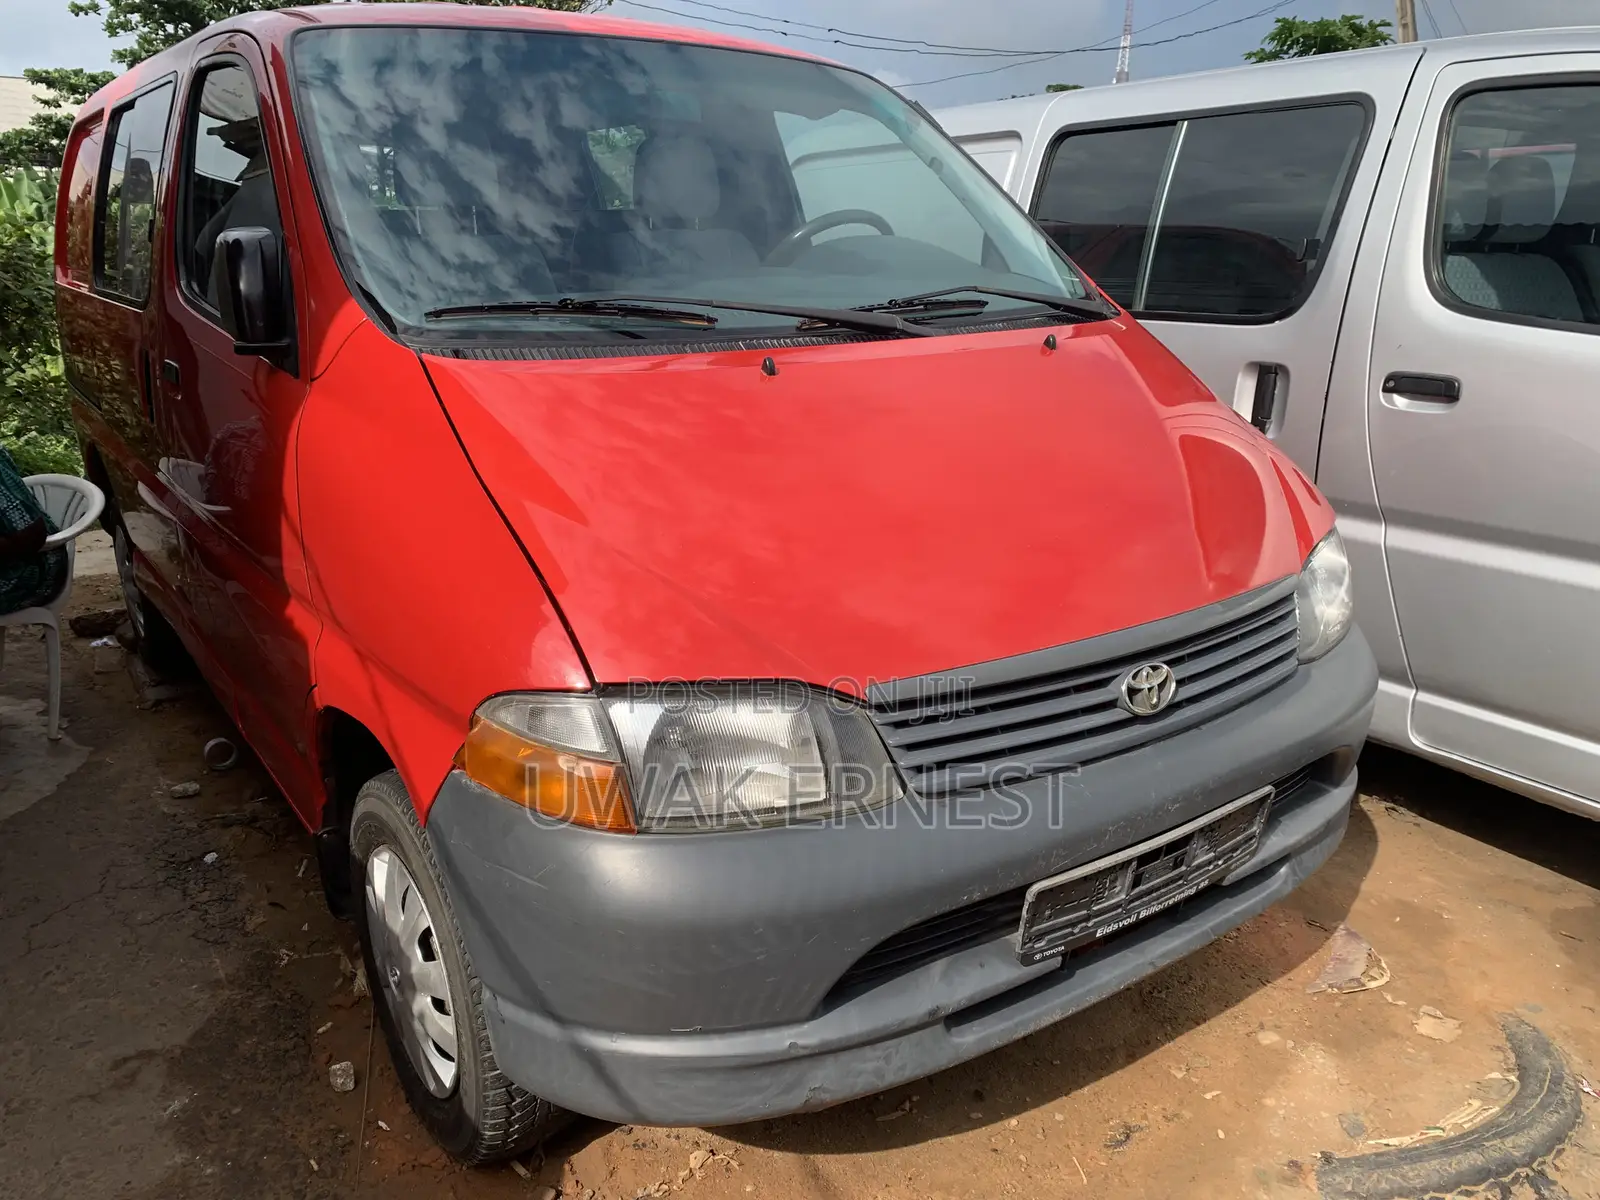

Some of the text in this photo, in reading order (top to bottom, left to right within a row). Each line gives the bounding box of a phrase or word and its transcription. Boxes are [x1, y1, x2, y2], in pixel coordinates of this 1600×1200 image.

[1095, 878, 1209, 938] Eidsvoll Bilforretning as
[1043, 945, 1065, 957] TOYOTA
